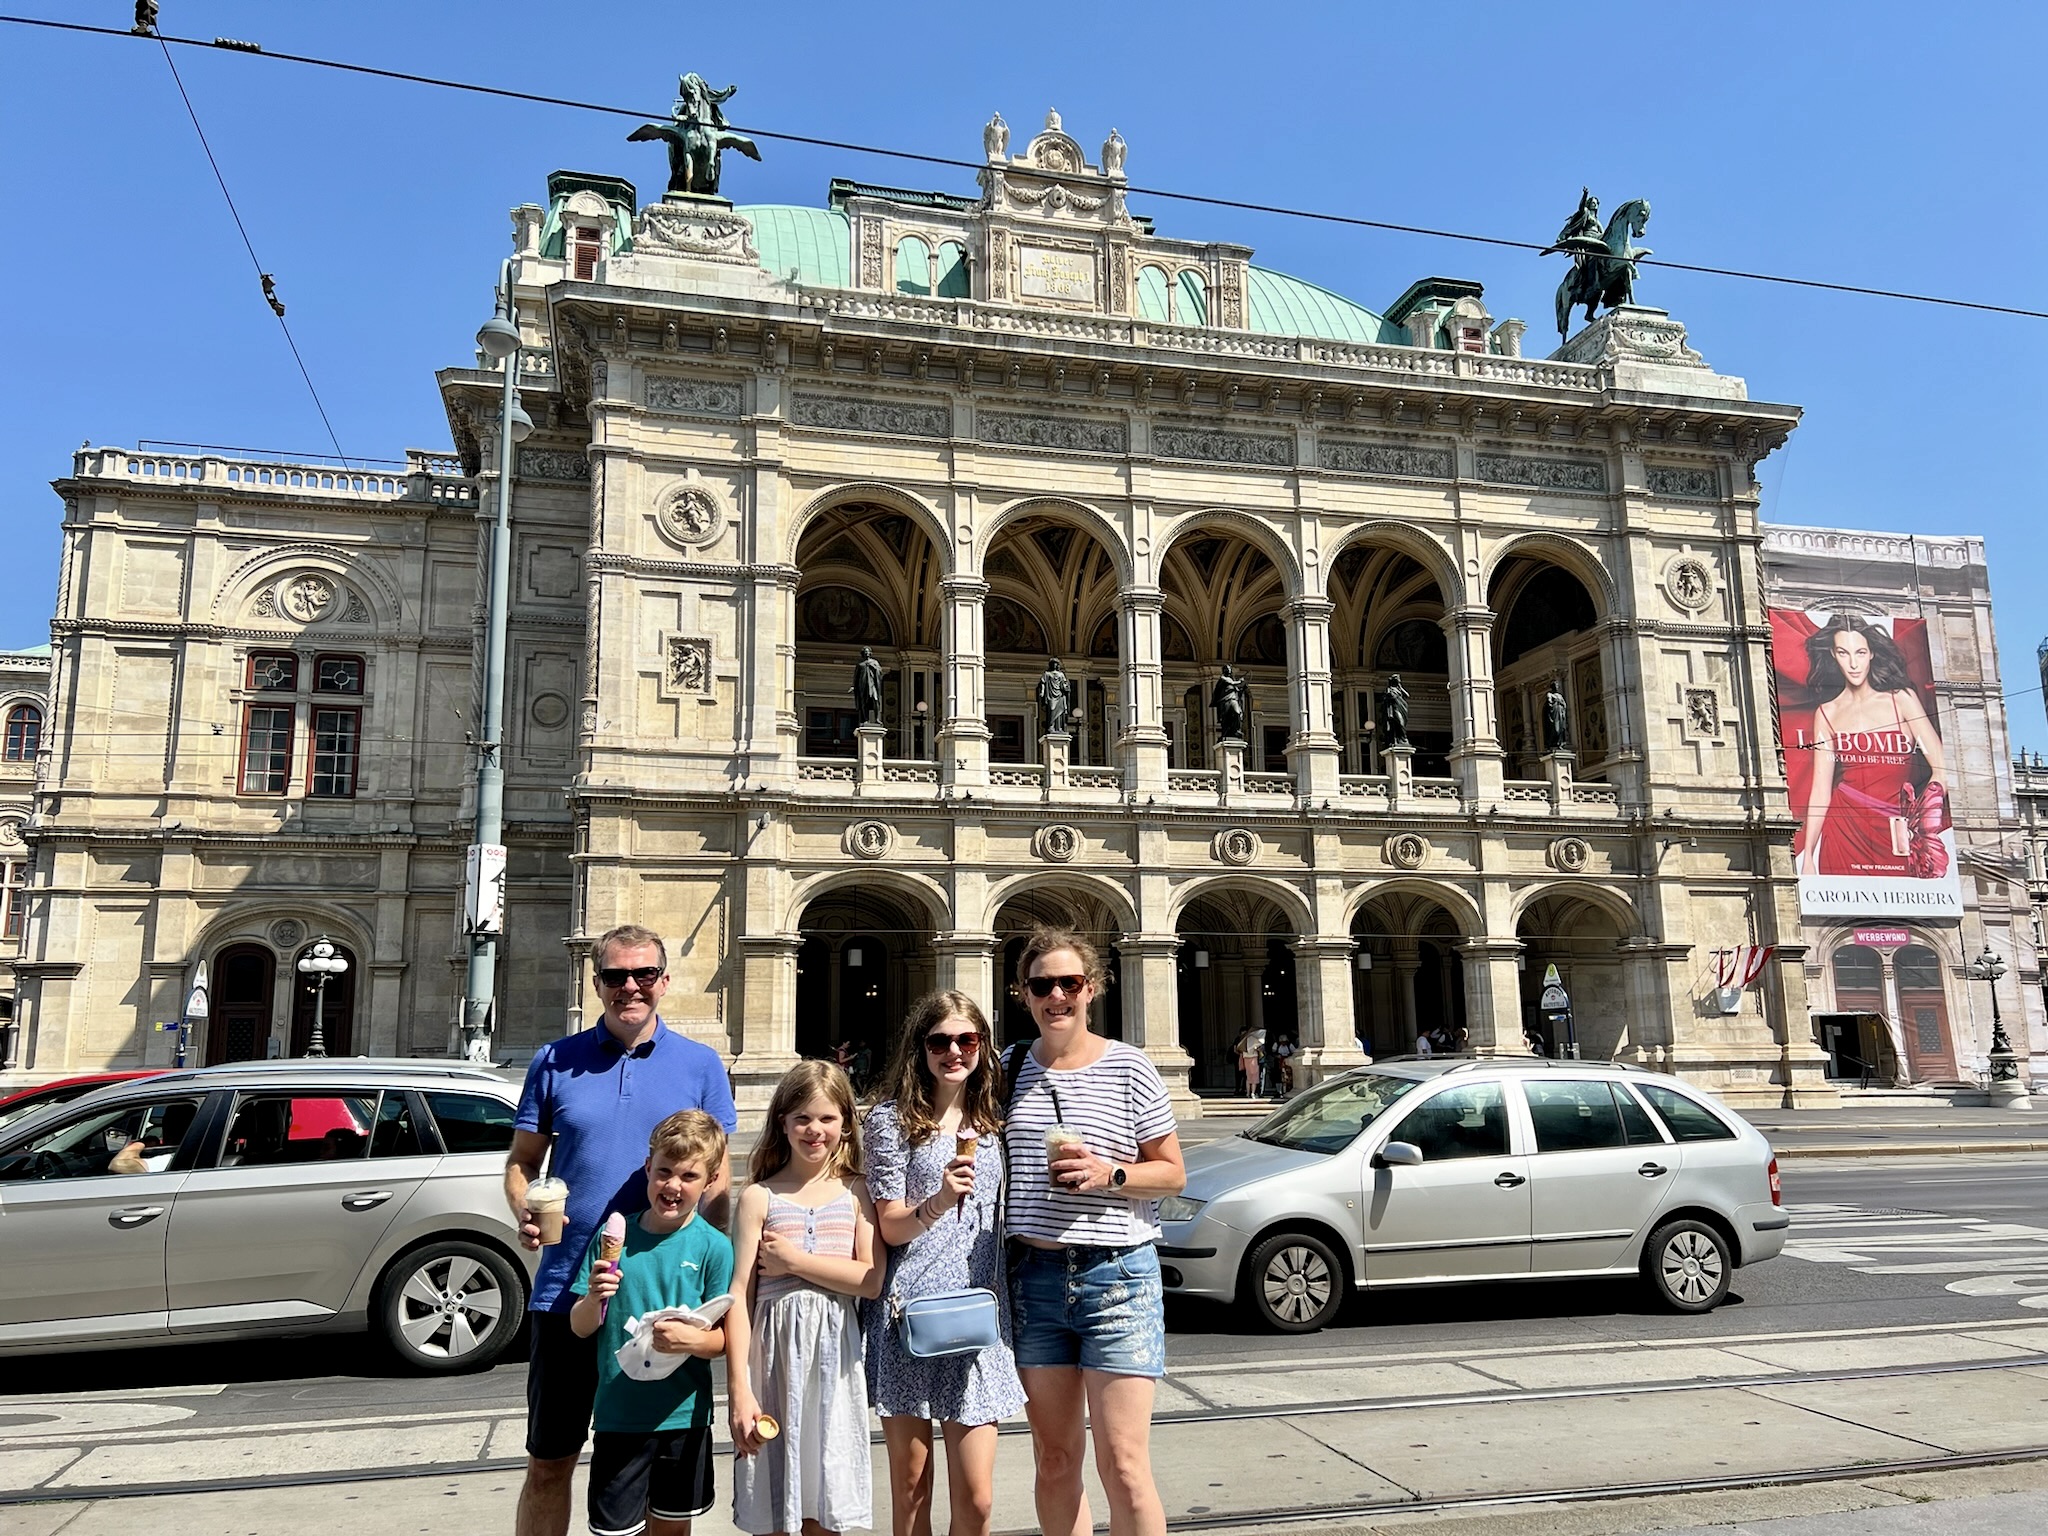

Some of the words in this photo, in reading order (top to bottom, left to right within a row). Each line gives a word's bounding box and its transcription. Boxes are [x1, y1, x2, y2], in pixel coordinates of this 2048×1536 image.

[1796, 729, 1831, 751] LA
[1836, 731, 1929, 754] BOMBA
[1840, 754, 1866, 763] LOUD
[1868, 755, 1879, 764] BE
[1881, 756, 1905, 765] FREE
[1805, 890, 1879, 903] CAROLINA
[1884, 892, 1955, 905] HERRERA
[1857, 932, 1907, 942] WERBEWAND
